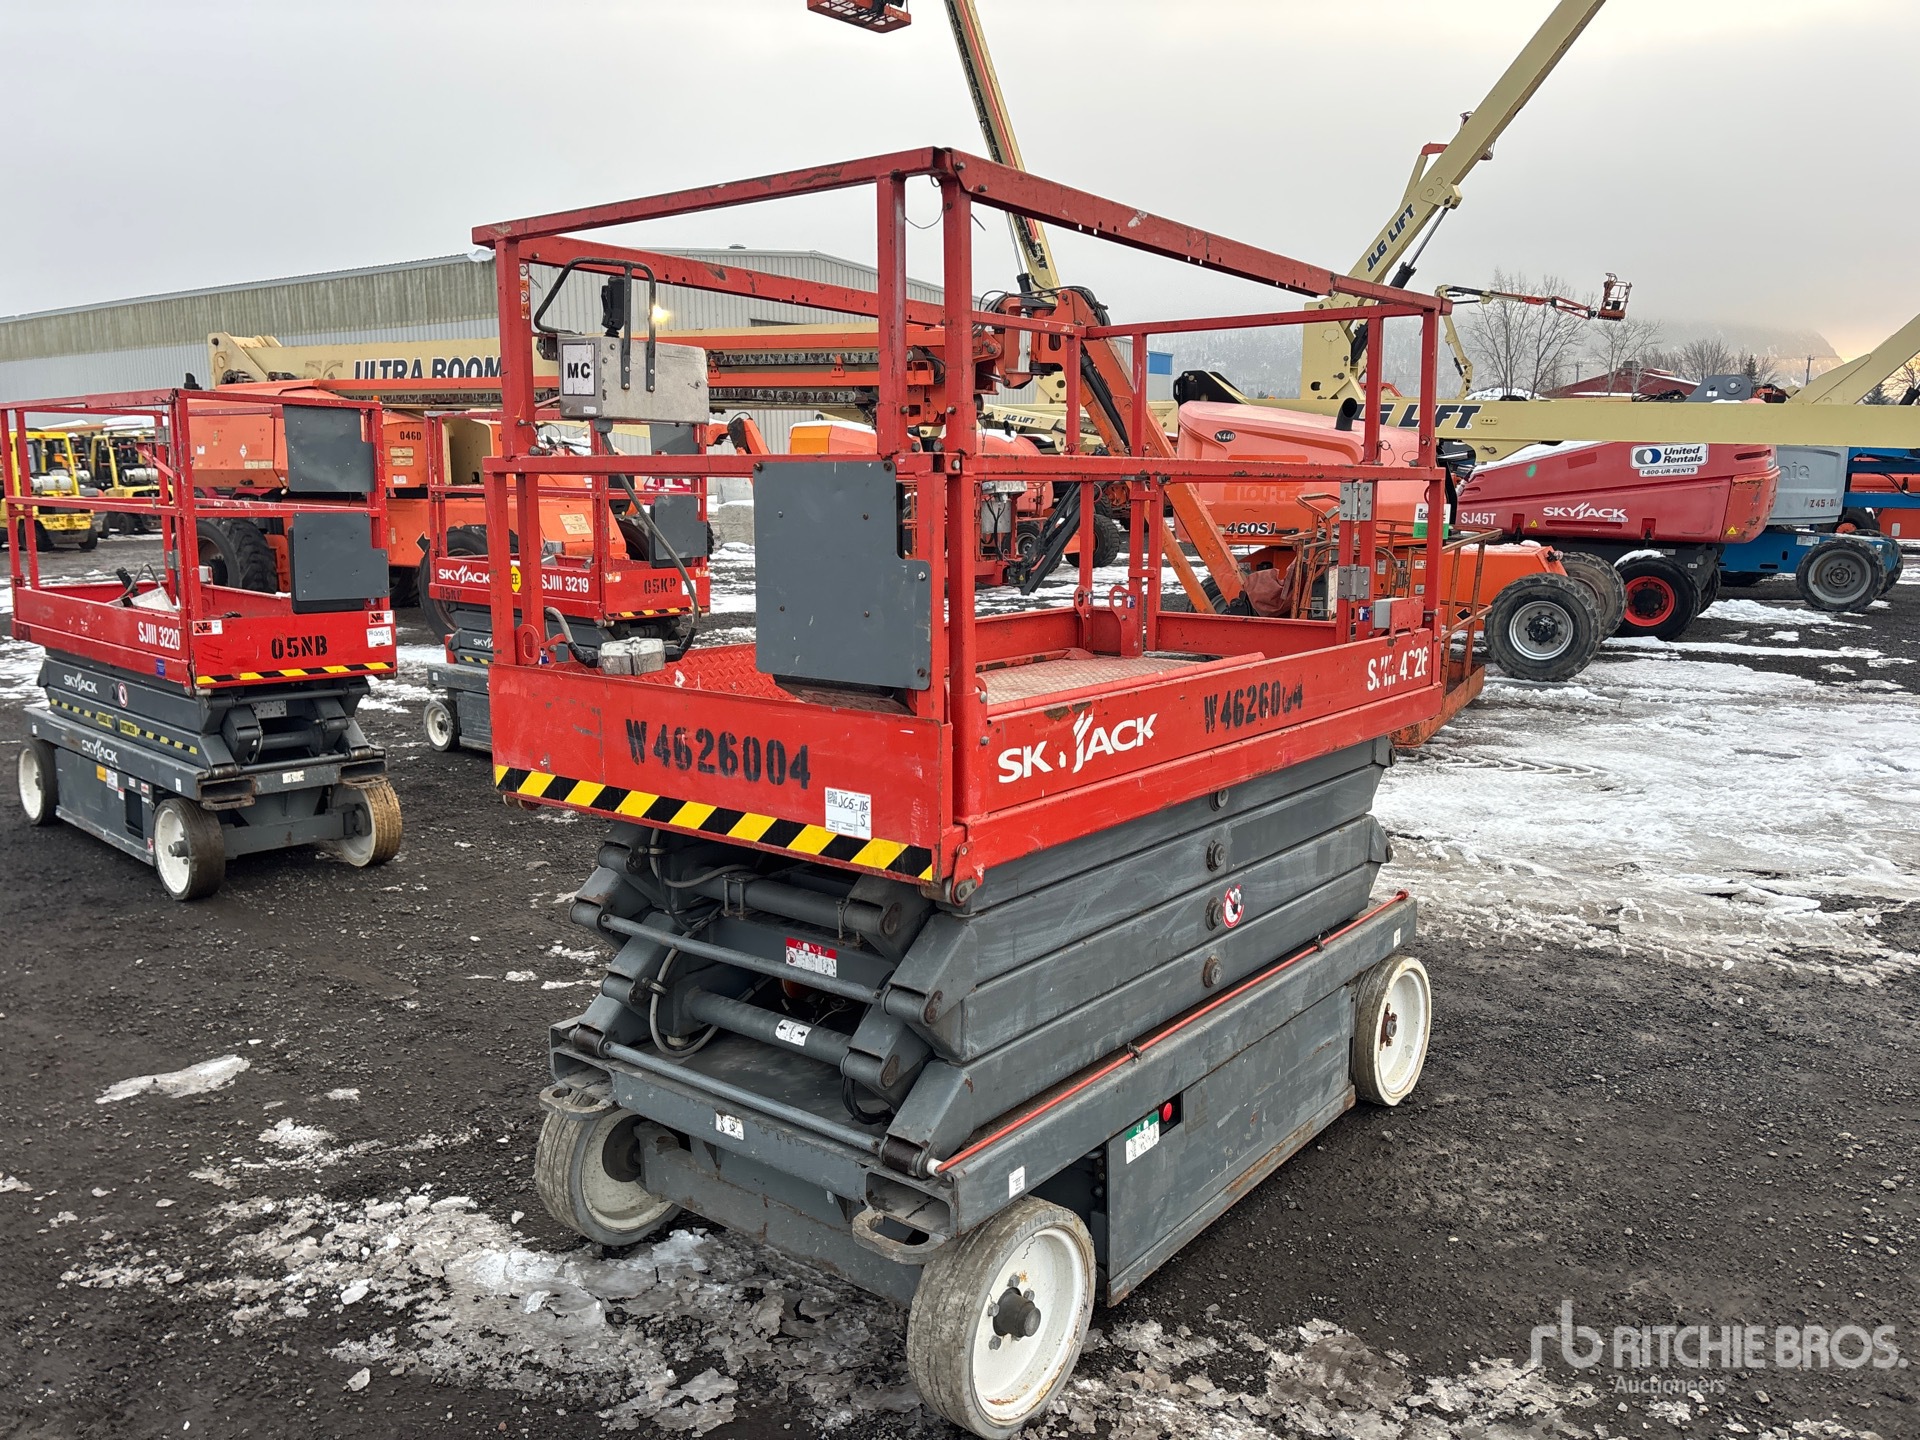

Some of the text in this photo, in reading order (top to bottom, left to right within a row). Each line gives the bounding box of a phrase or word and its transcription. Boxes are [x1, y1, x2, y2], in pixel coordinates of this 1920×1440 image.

[1367, 203, 1415, 273] JLG LIFT
[567, 362, 591, 379] MC
[1018, 416, 1035, 424] LIFT
[1216, 432, 1234, 440] N440
[1664, 446, 1700, 455] United
[1663, 455, 1703, 464] Rentals
[1461, 512, 1496, 525] SJ45T
[1543, 502, 1627, 519] SKYJACK
[1227, 523, 1276, 535] 460SJ
[438, 565, 490, 584] SKYJACK
[565, 575, 589, 593] 3219
[158, 625, 180, 651] 3220
[271, 635, 328, 659] 05NB
[64, 672, 98, 694] SKYJACK
[997, 708, 1158, 784] SKJACK
